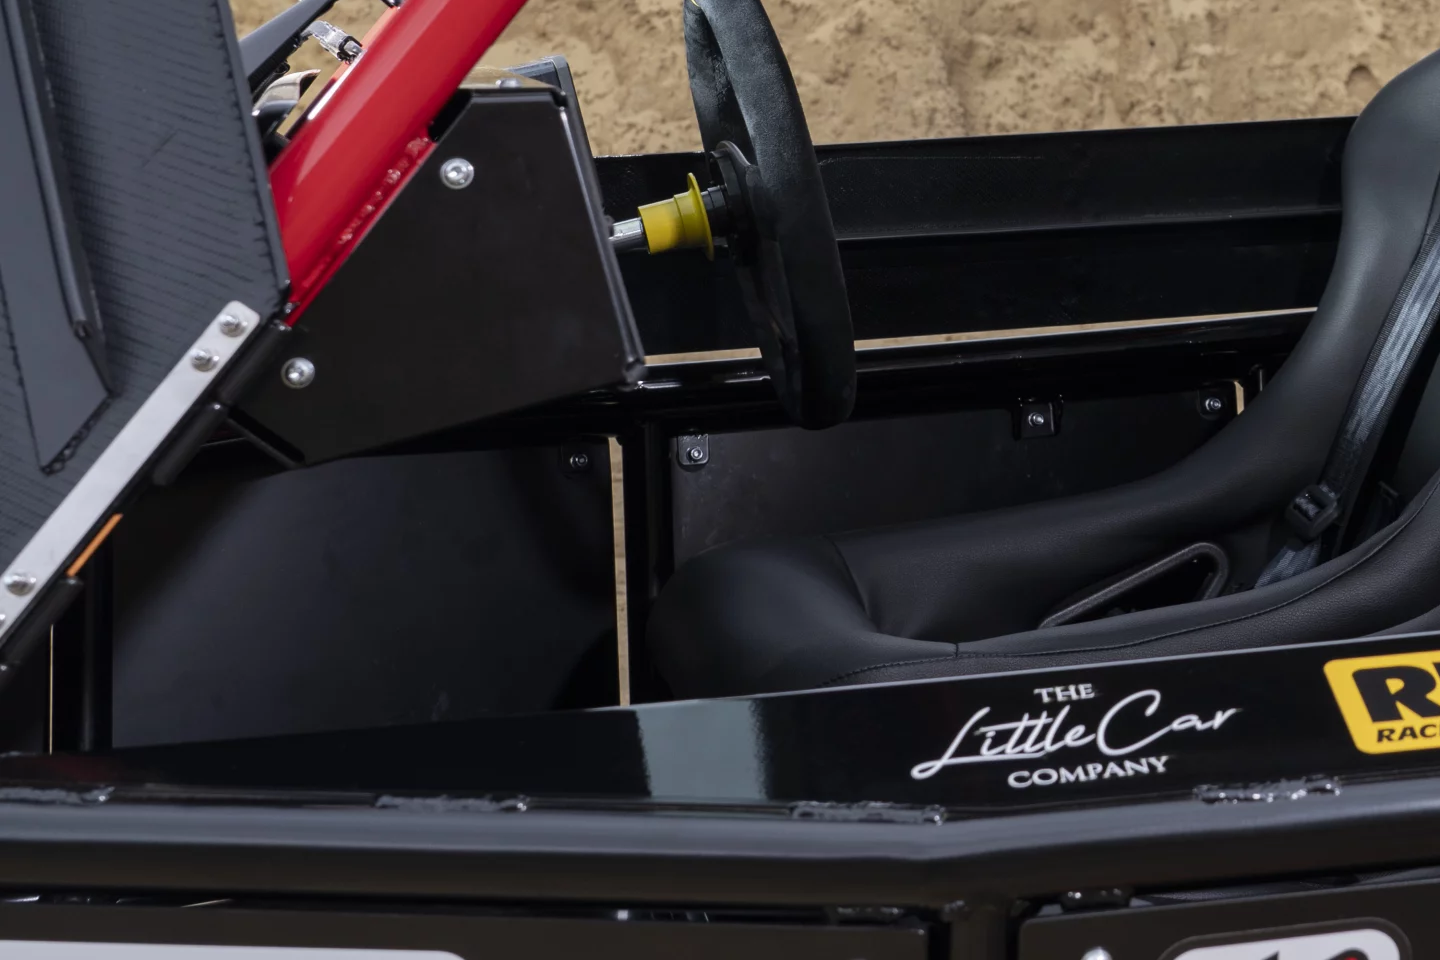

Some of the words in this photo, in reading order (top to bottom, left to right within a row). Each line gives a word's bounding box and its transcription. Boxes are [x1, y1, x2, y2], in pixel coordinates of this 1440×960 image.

[1034, 683, 1095, 703] THE
[911, 705, 1096, 779] Little
[1097, 689, 1240, 756] Car
[1008, 755, 1169, 788] COMPANY
